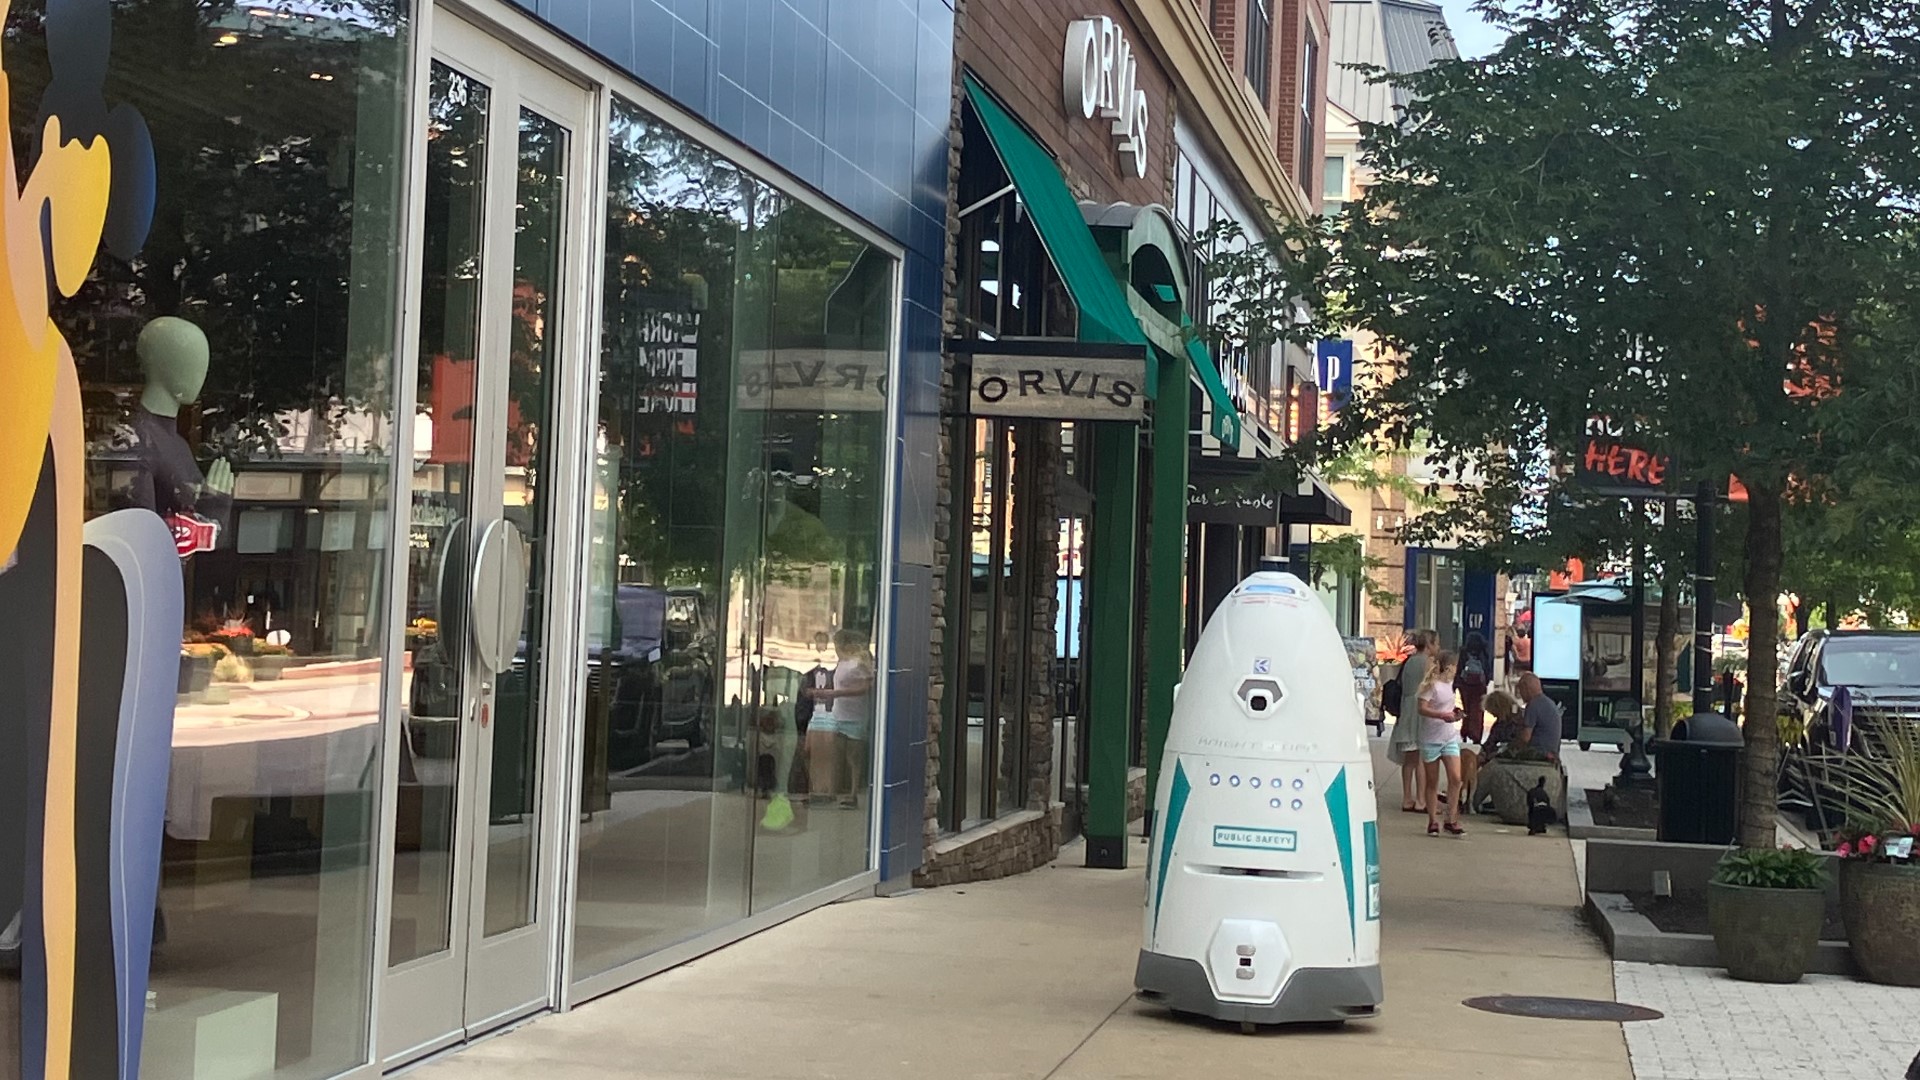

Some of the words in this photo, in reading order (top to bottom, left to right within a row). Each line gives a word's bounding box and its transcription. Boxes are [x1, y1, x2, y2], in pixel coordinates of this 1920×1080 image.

[448, 71, 468, 107] 236
[1070, 14, 1149, 180] ORVIS
[978, 368, 1137, 408] ORVIS
[1584, 440, 1669, 485] HERE
[1217, 832, 1251, 843] PUBLIC
[1255, 834, 1291, 845] SAFETY
